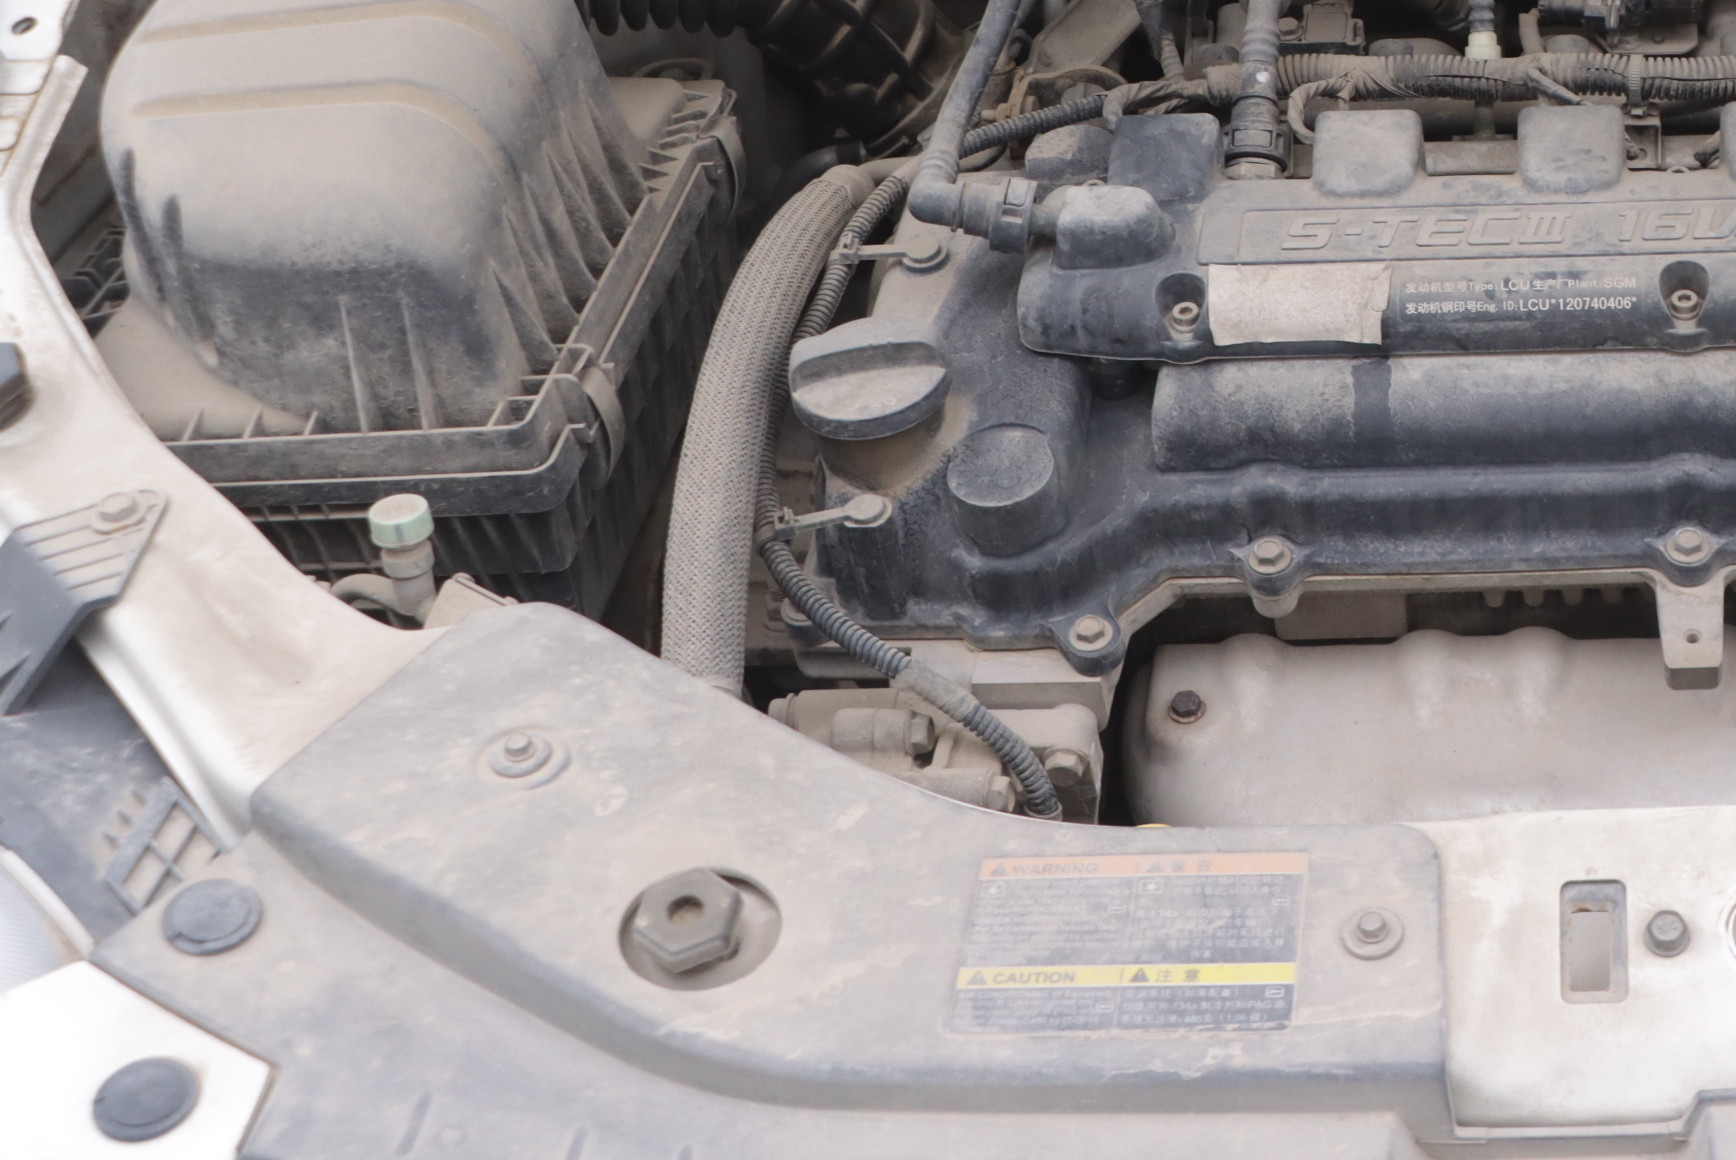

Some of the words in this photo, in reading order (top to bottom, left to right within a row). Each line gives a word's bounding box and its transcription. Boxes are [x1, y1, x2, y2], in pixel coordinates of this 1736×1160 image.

[1011, 861, 1099, 876] WARNING
[992, 970, 1077, 985] CAUTION
[1155, 968, 1201, 982] 注意
